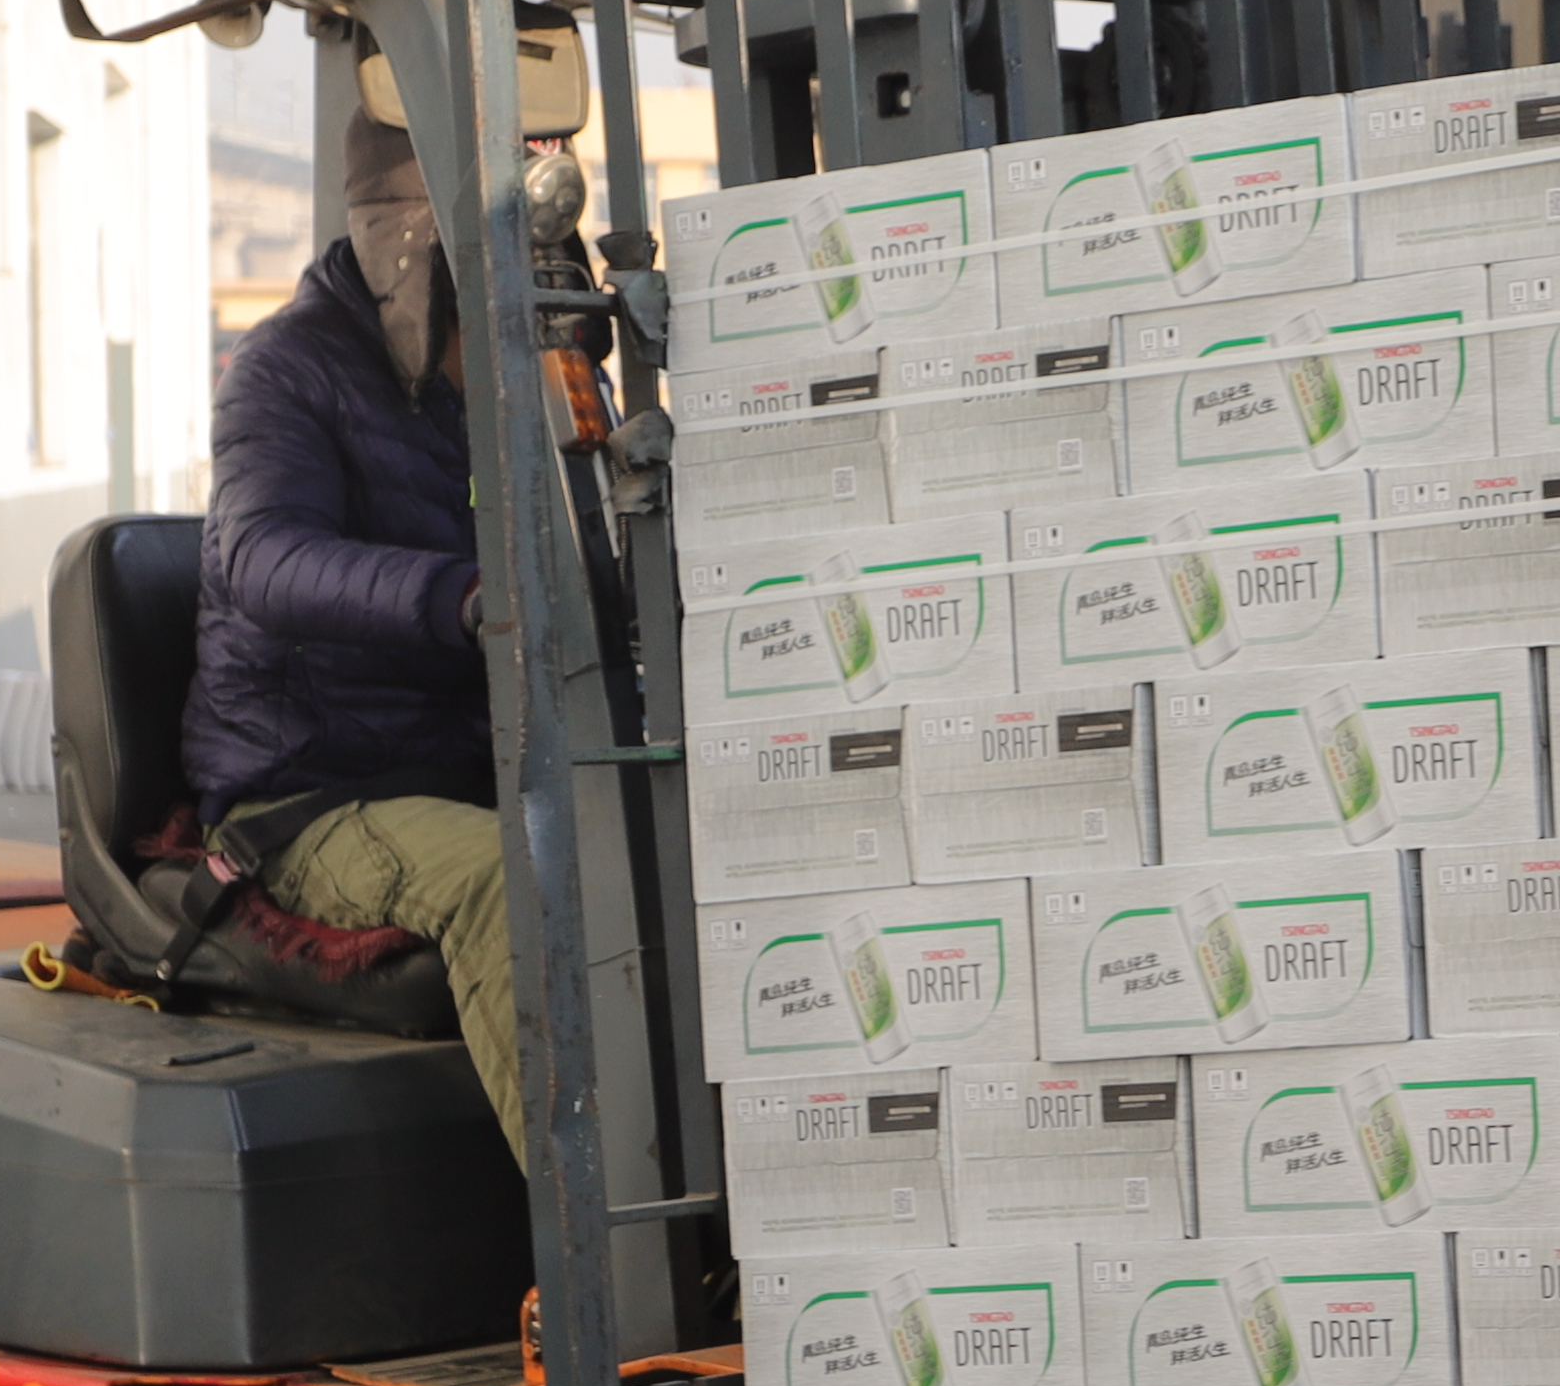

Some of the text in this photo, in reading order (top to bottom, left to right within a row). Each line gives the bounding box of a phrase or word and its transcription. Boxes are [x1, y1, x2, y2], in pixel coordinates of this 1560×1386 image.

[1449, 98, 1492, 113] TSINGTAO
[1435, 111, 1507, 153] DRAFT
[1235, 171, 1281, 187] TSINGTAO
[1219, 185, 1299, 232] DRAFT
[886, 222, 929, 238] TSINGTAO
[872, 236, 945, 282] DRAFT
[975, 351, 1014, 364] TSINGTAO
[1373, 343, 1423, 360] TSINGTAO
[752, 381, 790, 395] TSINGTAO
[962, 363, 1027, 403] DRAFT
[1358, 359, 1440, 405] DRAFT
[740, 393, 802, 432] DRAFT
[1473, 476, 1518, 490] TSINGTAO
[1457, 489, 1536, 530] DRAFT
[1254, 546, 1301, 561] TSINGTAO
[902, 585, 945, 599] TSINGTAO
[1238, 561, 1318, 606] DRAFT
[887, 599, 961, 642] DRAFT
[995, 711, 1035, 724] TSINGTAO
[771, 732, 809, 745] TSINGTAO
[983, 725, 1048, 761] DRAFT
[1410, 724, 1459, 738] TSINGTAO
[759, 745, 821, 782] DRAFT
[1393, 740, 1477, 783] DRAFT
[1282, 923, 1330, 937] TSINGTAO
[922, 948, 966, 961] TSINGTAO
[1265, 940, 1347, 982] DRAFT
[908, 963, 981, 1004] DRAFT
[809, 1092, 848, 1104] TSINGTAO
[1038, 1079, 1080, 1091] TSINGTAO
[797, 1106, 859, 1141] DRAFT
[1027, 1094, 1092, 1129] DRAFT
[1446, 1107, 1495, 1121] TSINGTAO
[1429, 1124, 1513, 1165] DRAFT
[970, 1311, 1015, 1324] TSINGTAO
[1327, 1301, 1376, 1314] TSINGTAO
[955, 1327, 1031, 1366] DRAFT
[1311, 1319, 1393, 1358] DRAFT
